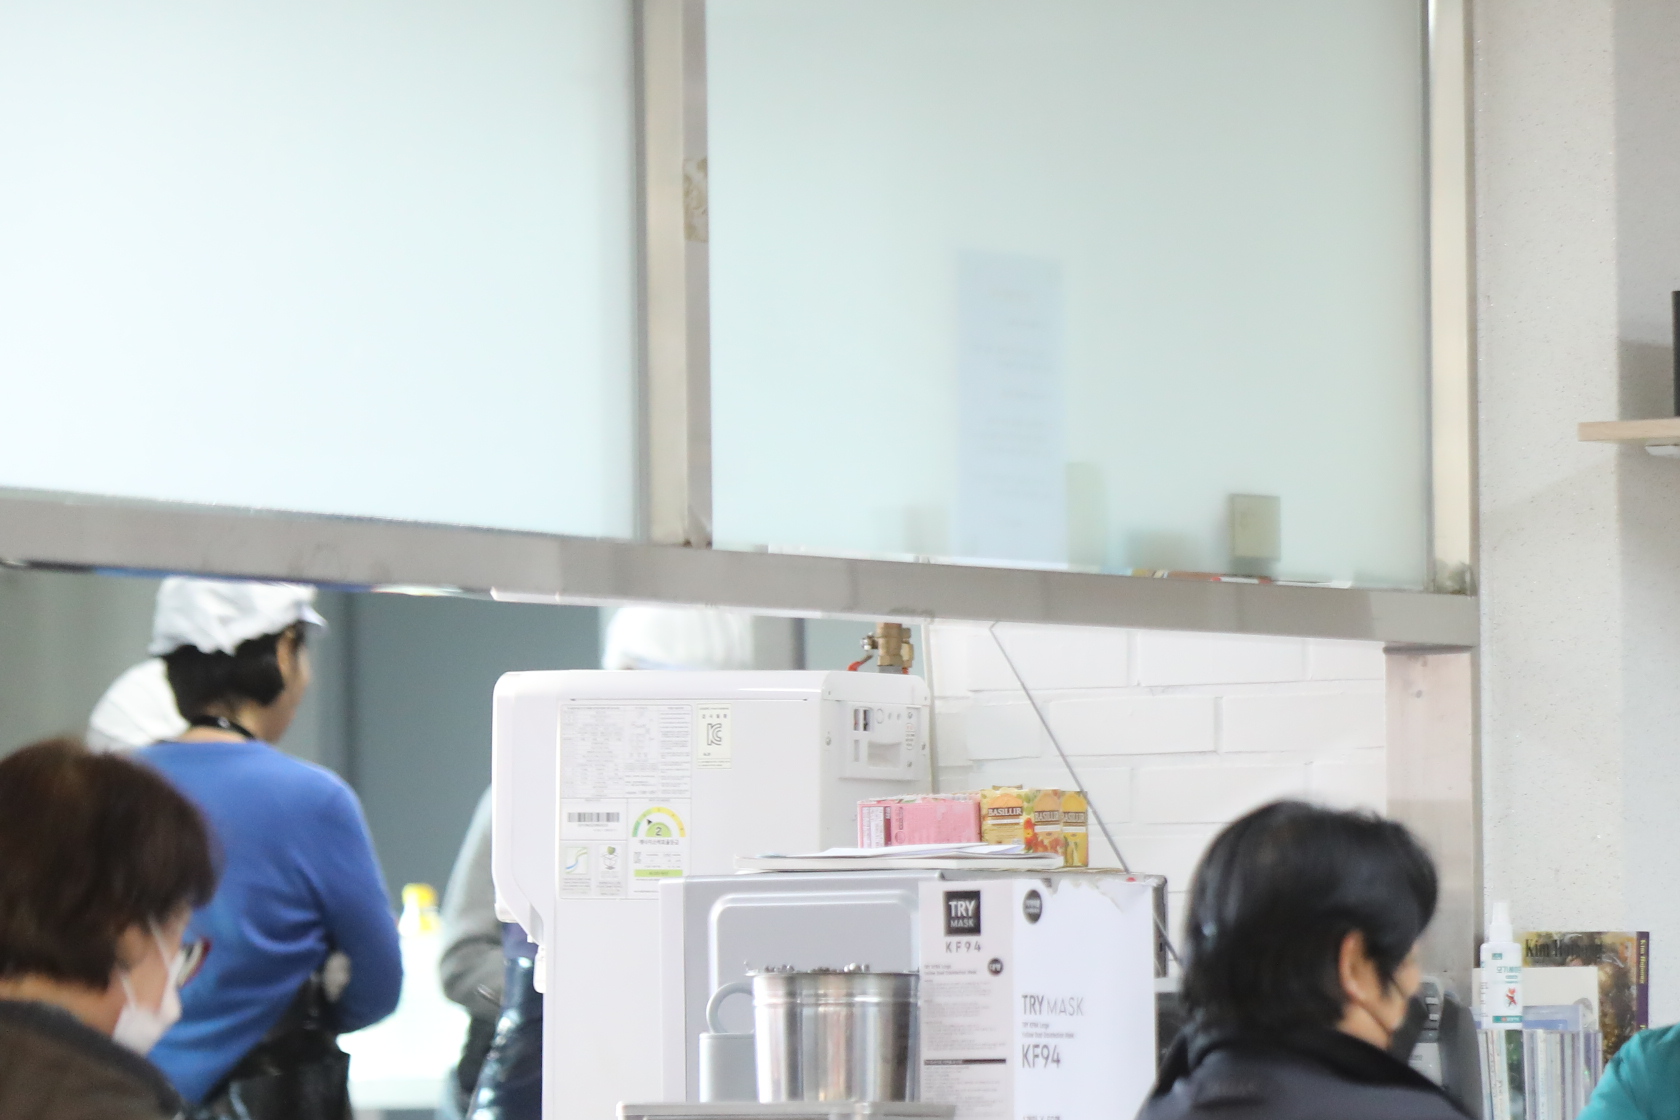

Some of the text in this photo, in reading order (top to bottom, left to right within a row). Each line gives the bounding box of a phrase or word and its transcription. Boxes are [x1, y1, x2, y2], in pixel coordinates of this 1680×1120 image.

[655, 826, 662, 836] 2
[948, 900, 976, 917] TRY
[950, 918, 975, 928] MASK
[945, 941, 982, 953] KF94
[1525, 938, 1550, 957] Kim
[1021, 994, 1084, 1016] TRY MASK
[1021, 1044, 1061, 1069] KF94
